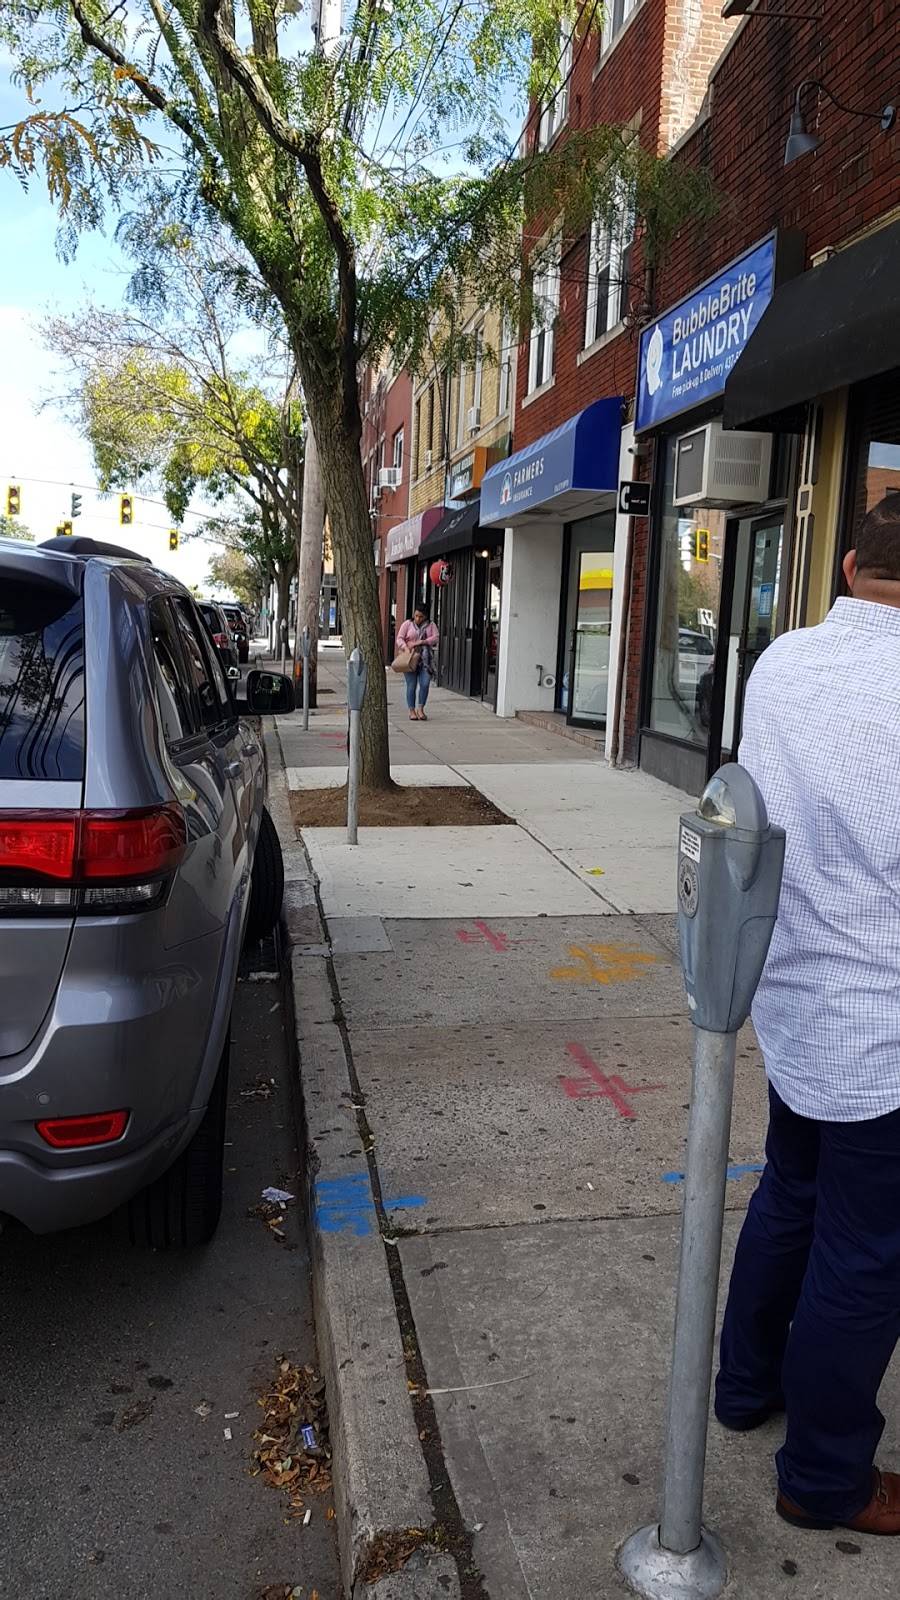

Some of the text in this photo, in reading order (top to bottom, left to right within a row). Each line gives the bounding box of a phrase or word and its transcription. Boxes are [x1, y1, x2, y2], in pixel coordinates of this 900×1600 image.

[672, 272, 757, 346] BubbleBrite
[672, 302, 754, 381] LAUNDRY
[672, 385, 682, 398] Free
[682, 375, 699, 396] pick-up
[703, 363, 724, 382] Delivery
[513, 457, 545, 488] FARMERS
